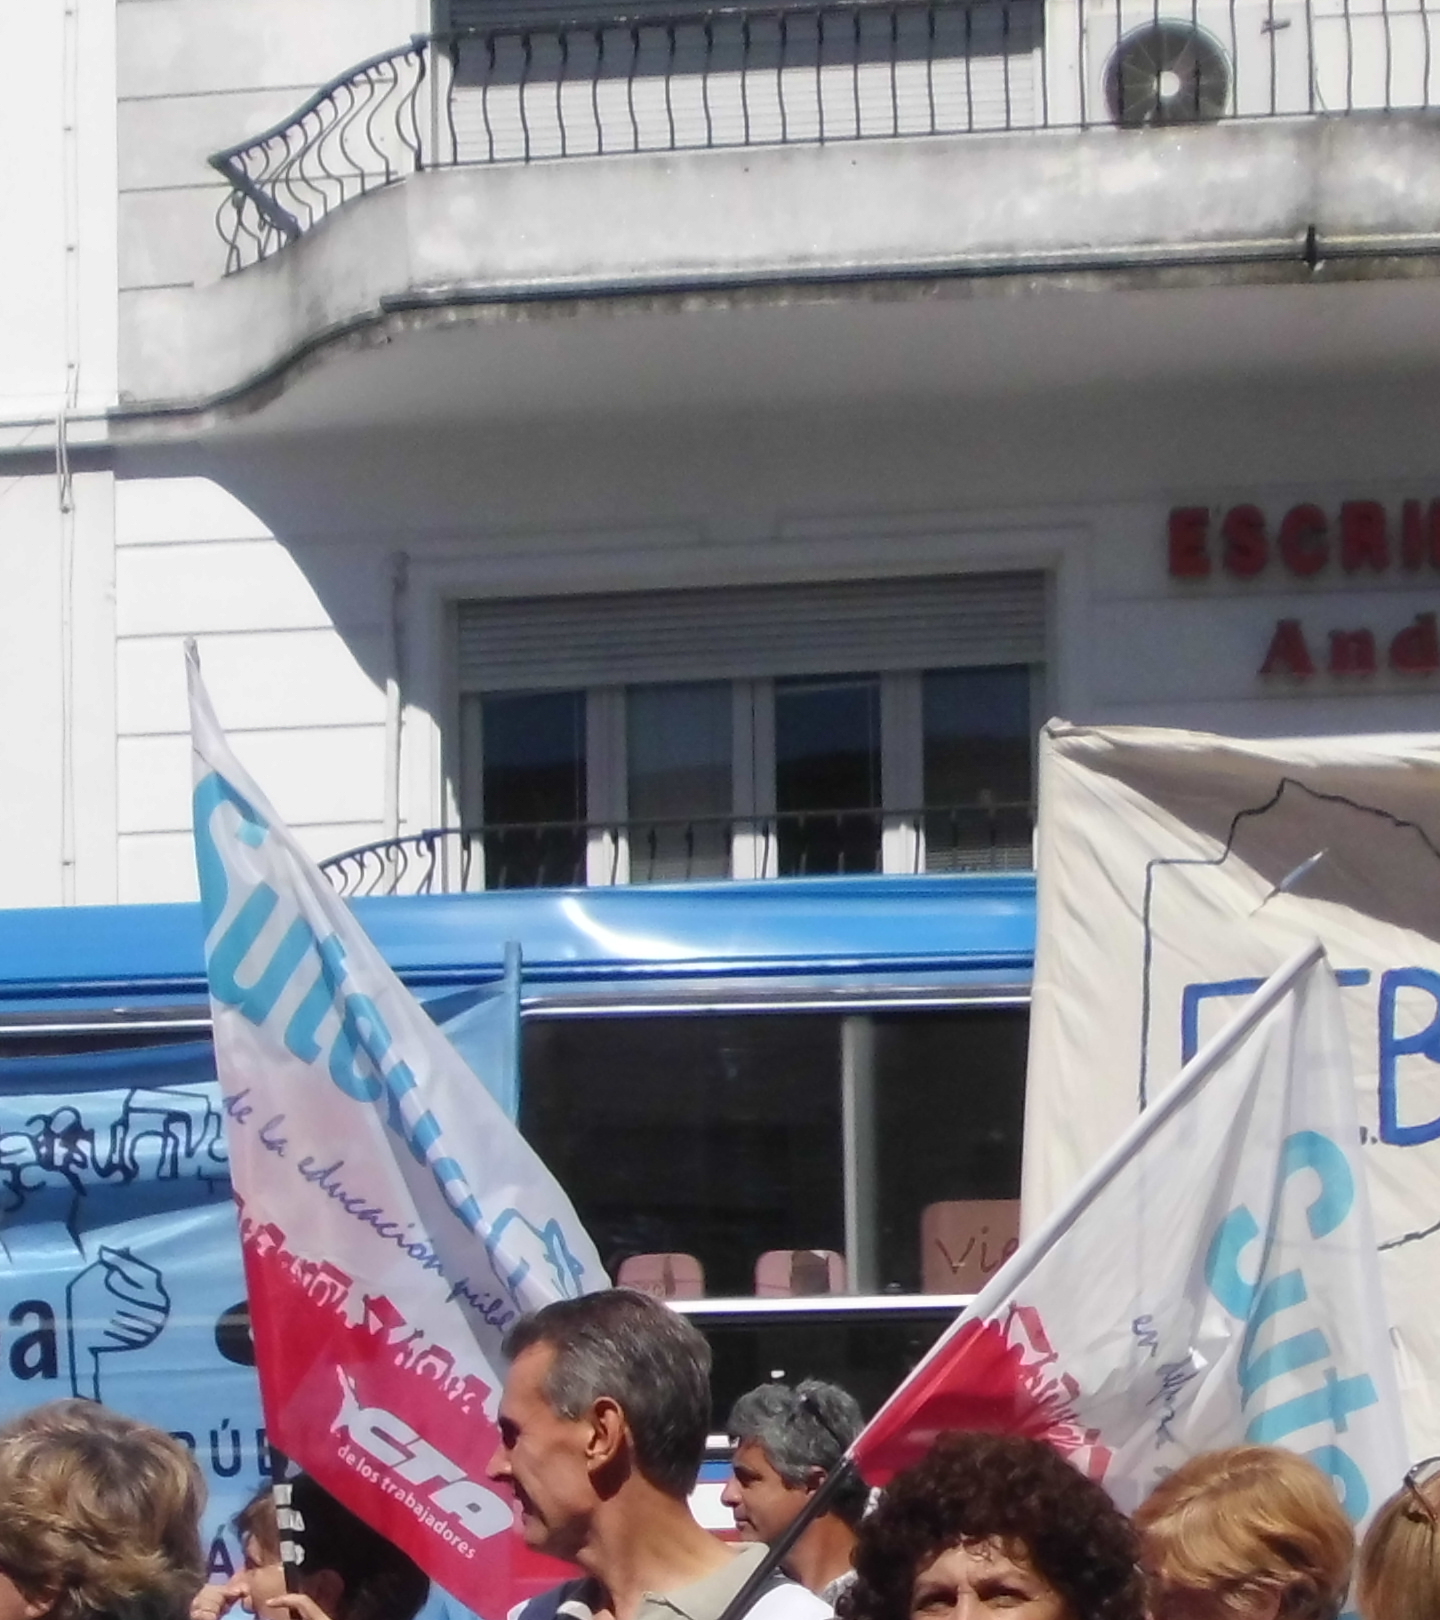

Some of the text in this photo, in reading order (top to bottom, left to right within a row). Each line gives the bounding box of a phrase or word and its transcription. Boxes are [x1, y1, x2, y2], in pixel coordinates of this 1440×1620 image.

[224, 1088, 252, 1124] de
[259, 1114, 288, 1157] la
[337, 1445, 476, 1559] de los trabajadores
